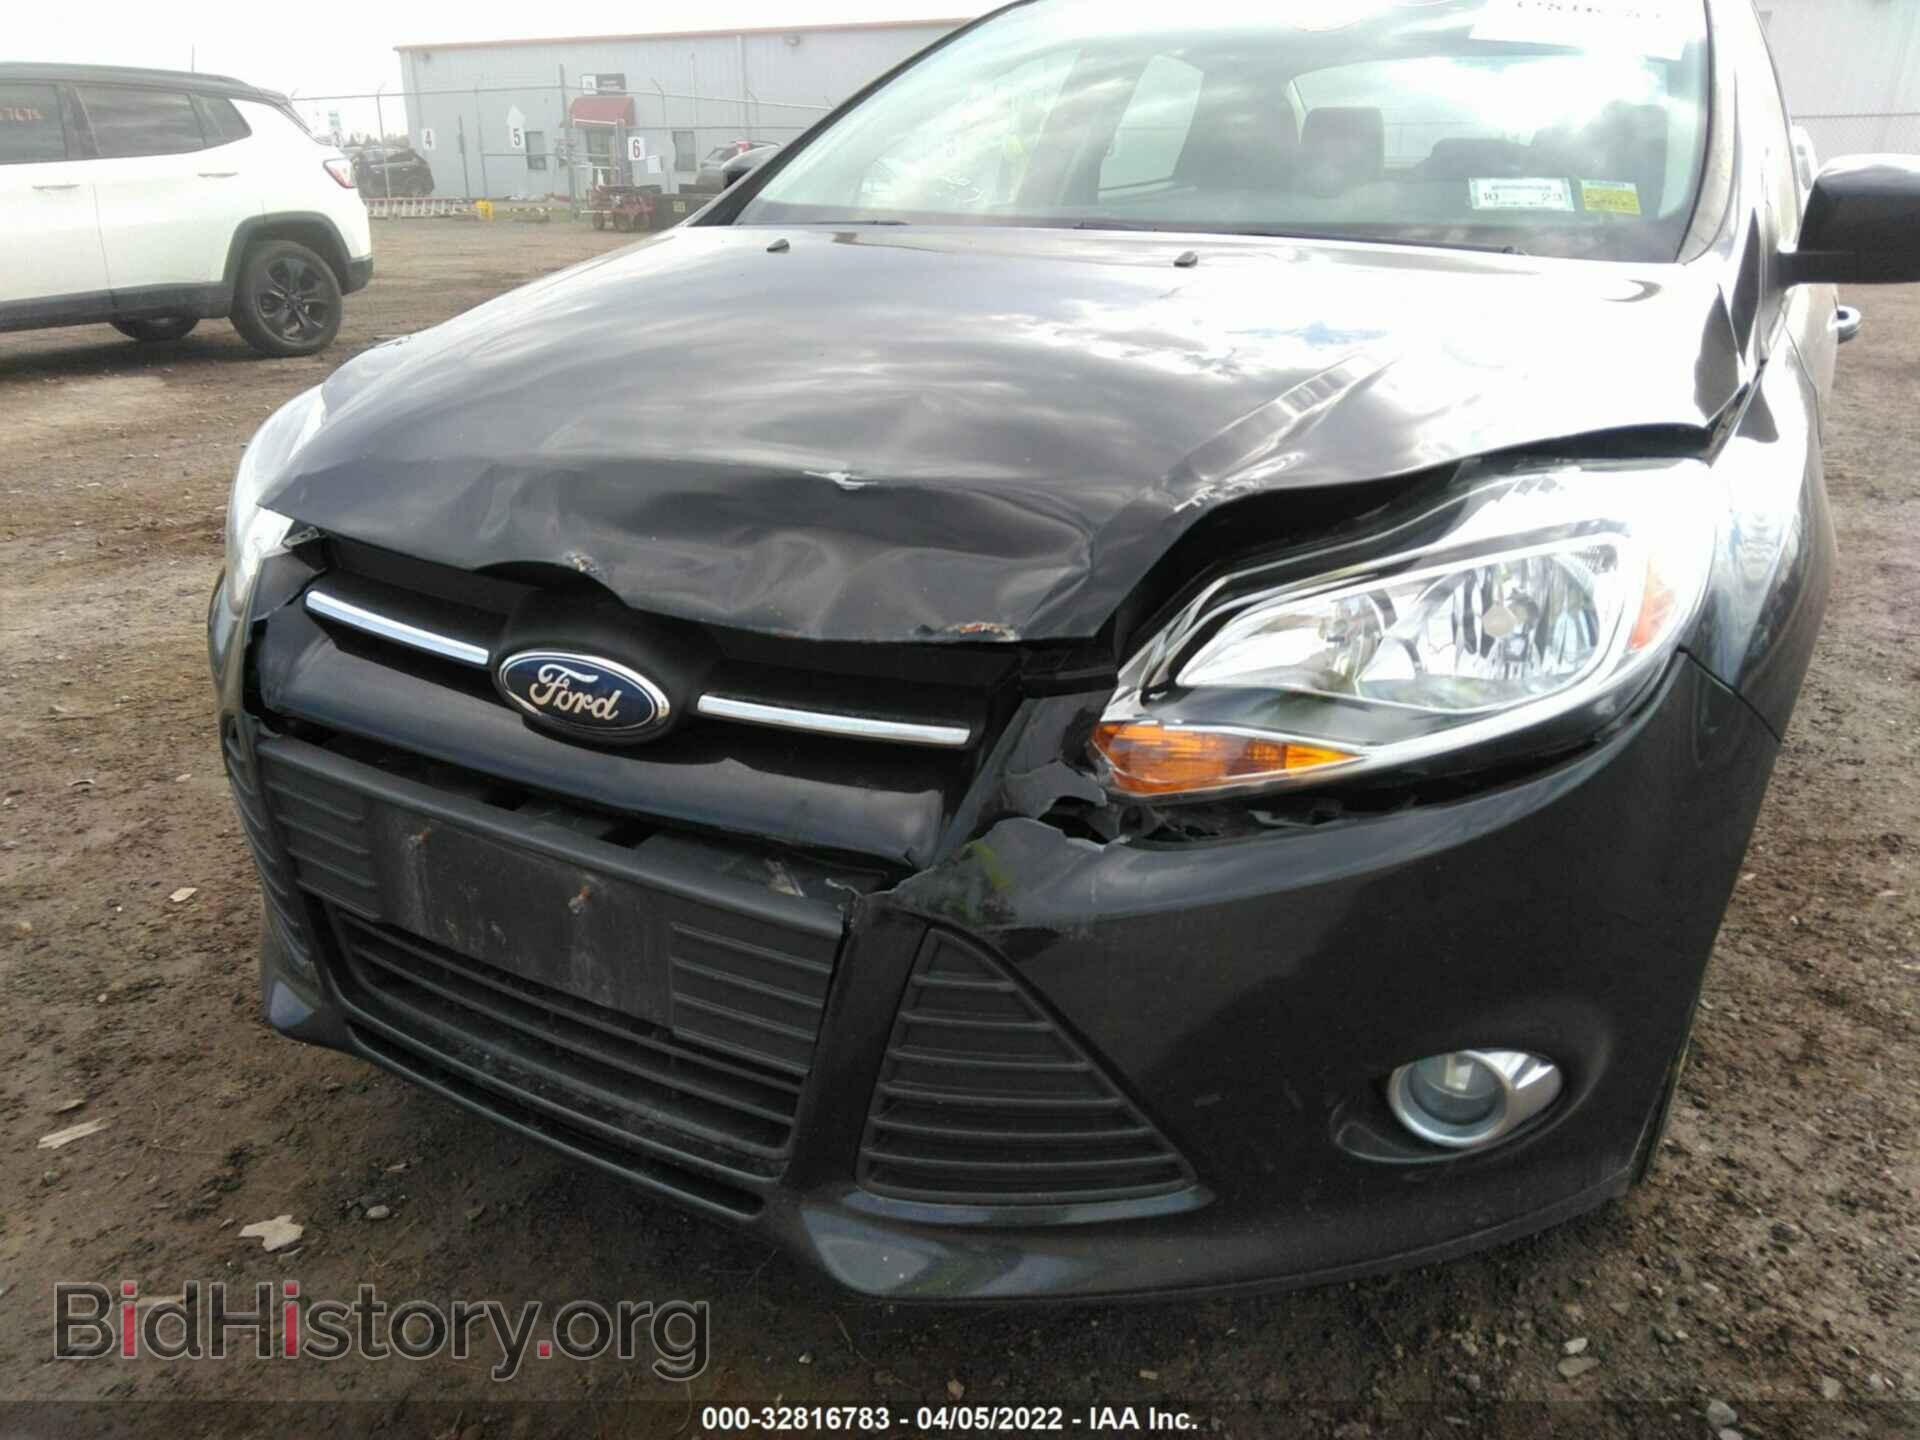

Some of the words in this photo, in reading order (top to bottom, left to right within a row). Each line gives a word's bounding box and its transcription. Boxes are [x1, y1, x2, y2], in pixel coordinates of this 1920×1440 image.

[424, 130, 433, 149] 4
[512, 128, 521, 147] 5
[632, 139, 641, 159] 6
[529, 663, 623, 721] Ford
